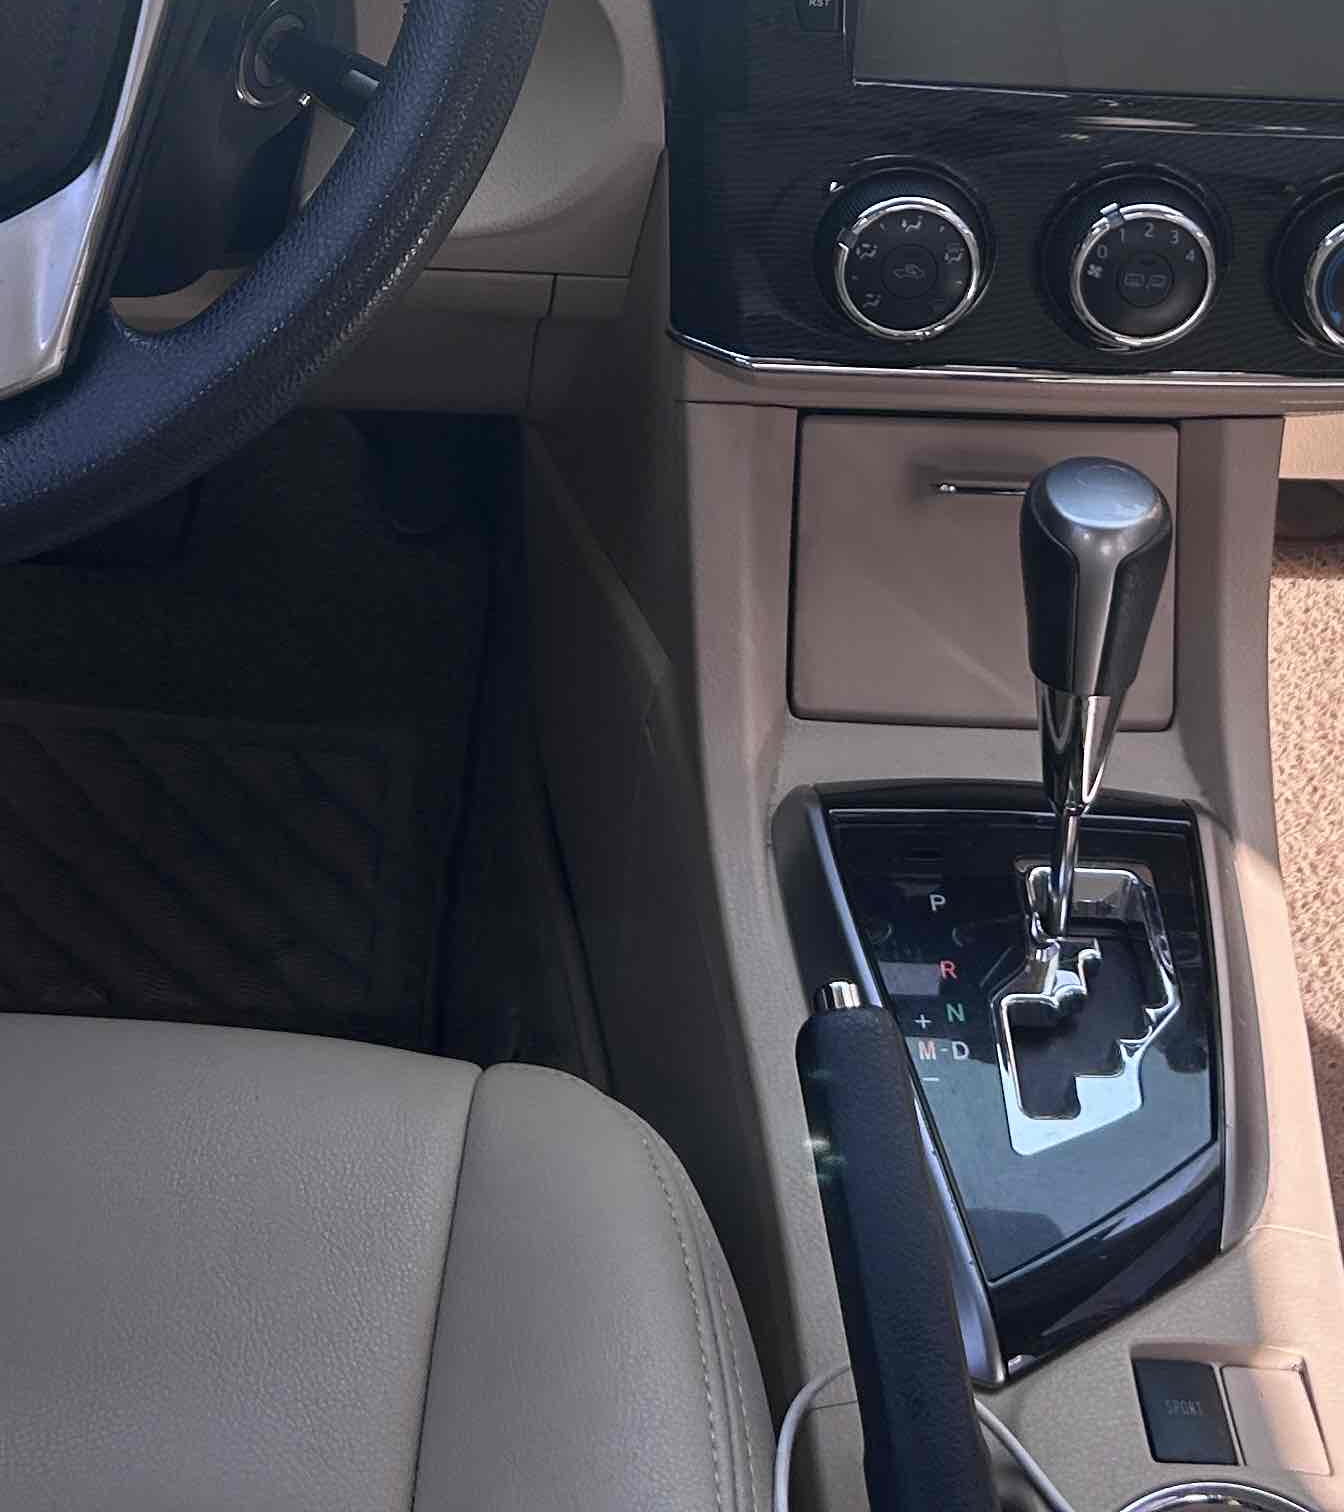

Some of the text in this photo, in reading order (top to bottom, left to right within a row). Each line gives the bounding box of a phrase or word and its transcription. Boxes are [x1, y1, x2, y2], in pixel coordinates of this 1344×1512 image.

[1097, 222, 1196, 263] 0 1 2 3 4
[929, 893, 946, 912] P
[939, 960, 958, 979] R
[946, 1002, 966, 1023] N
